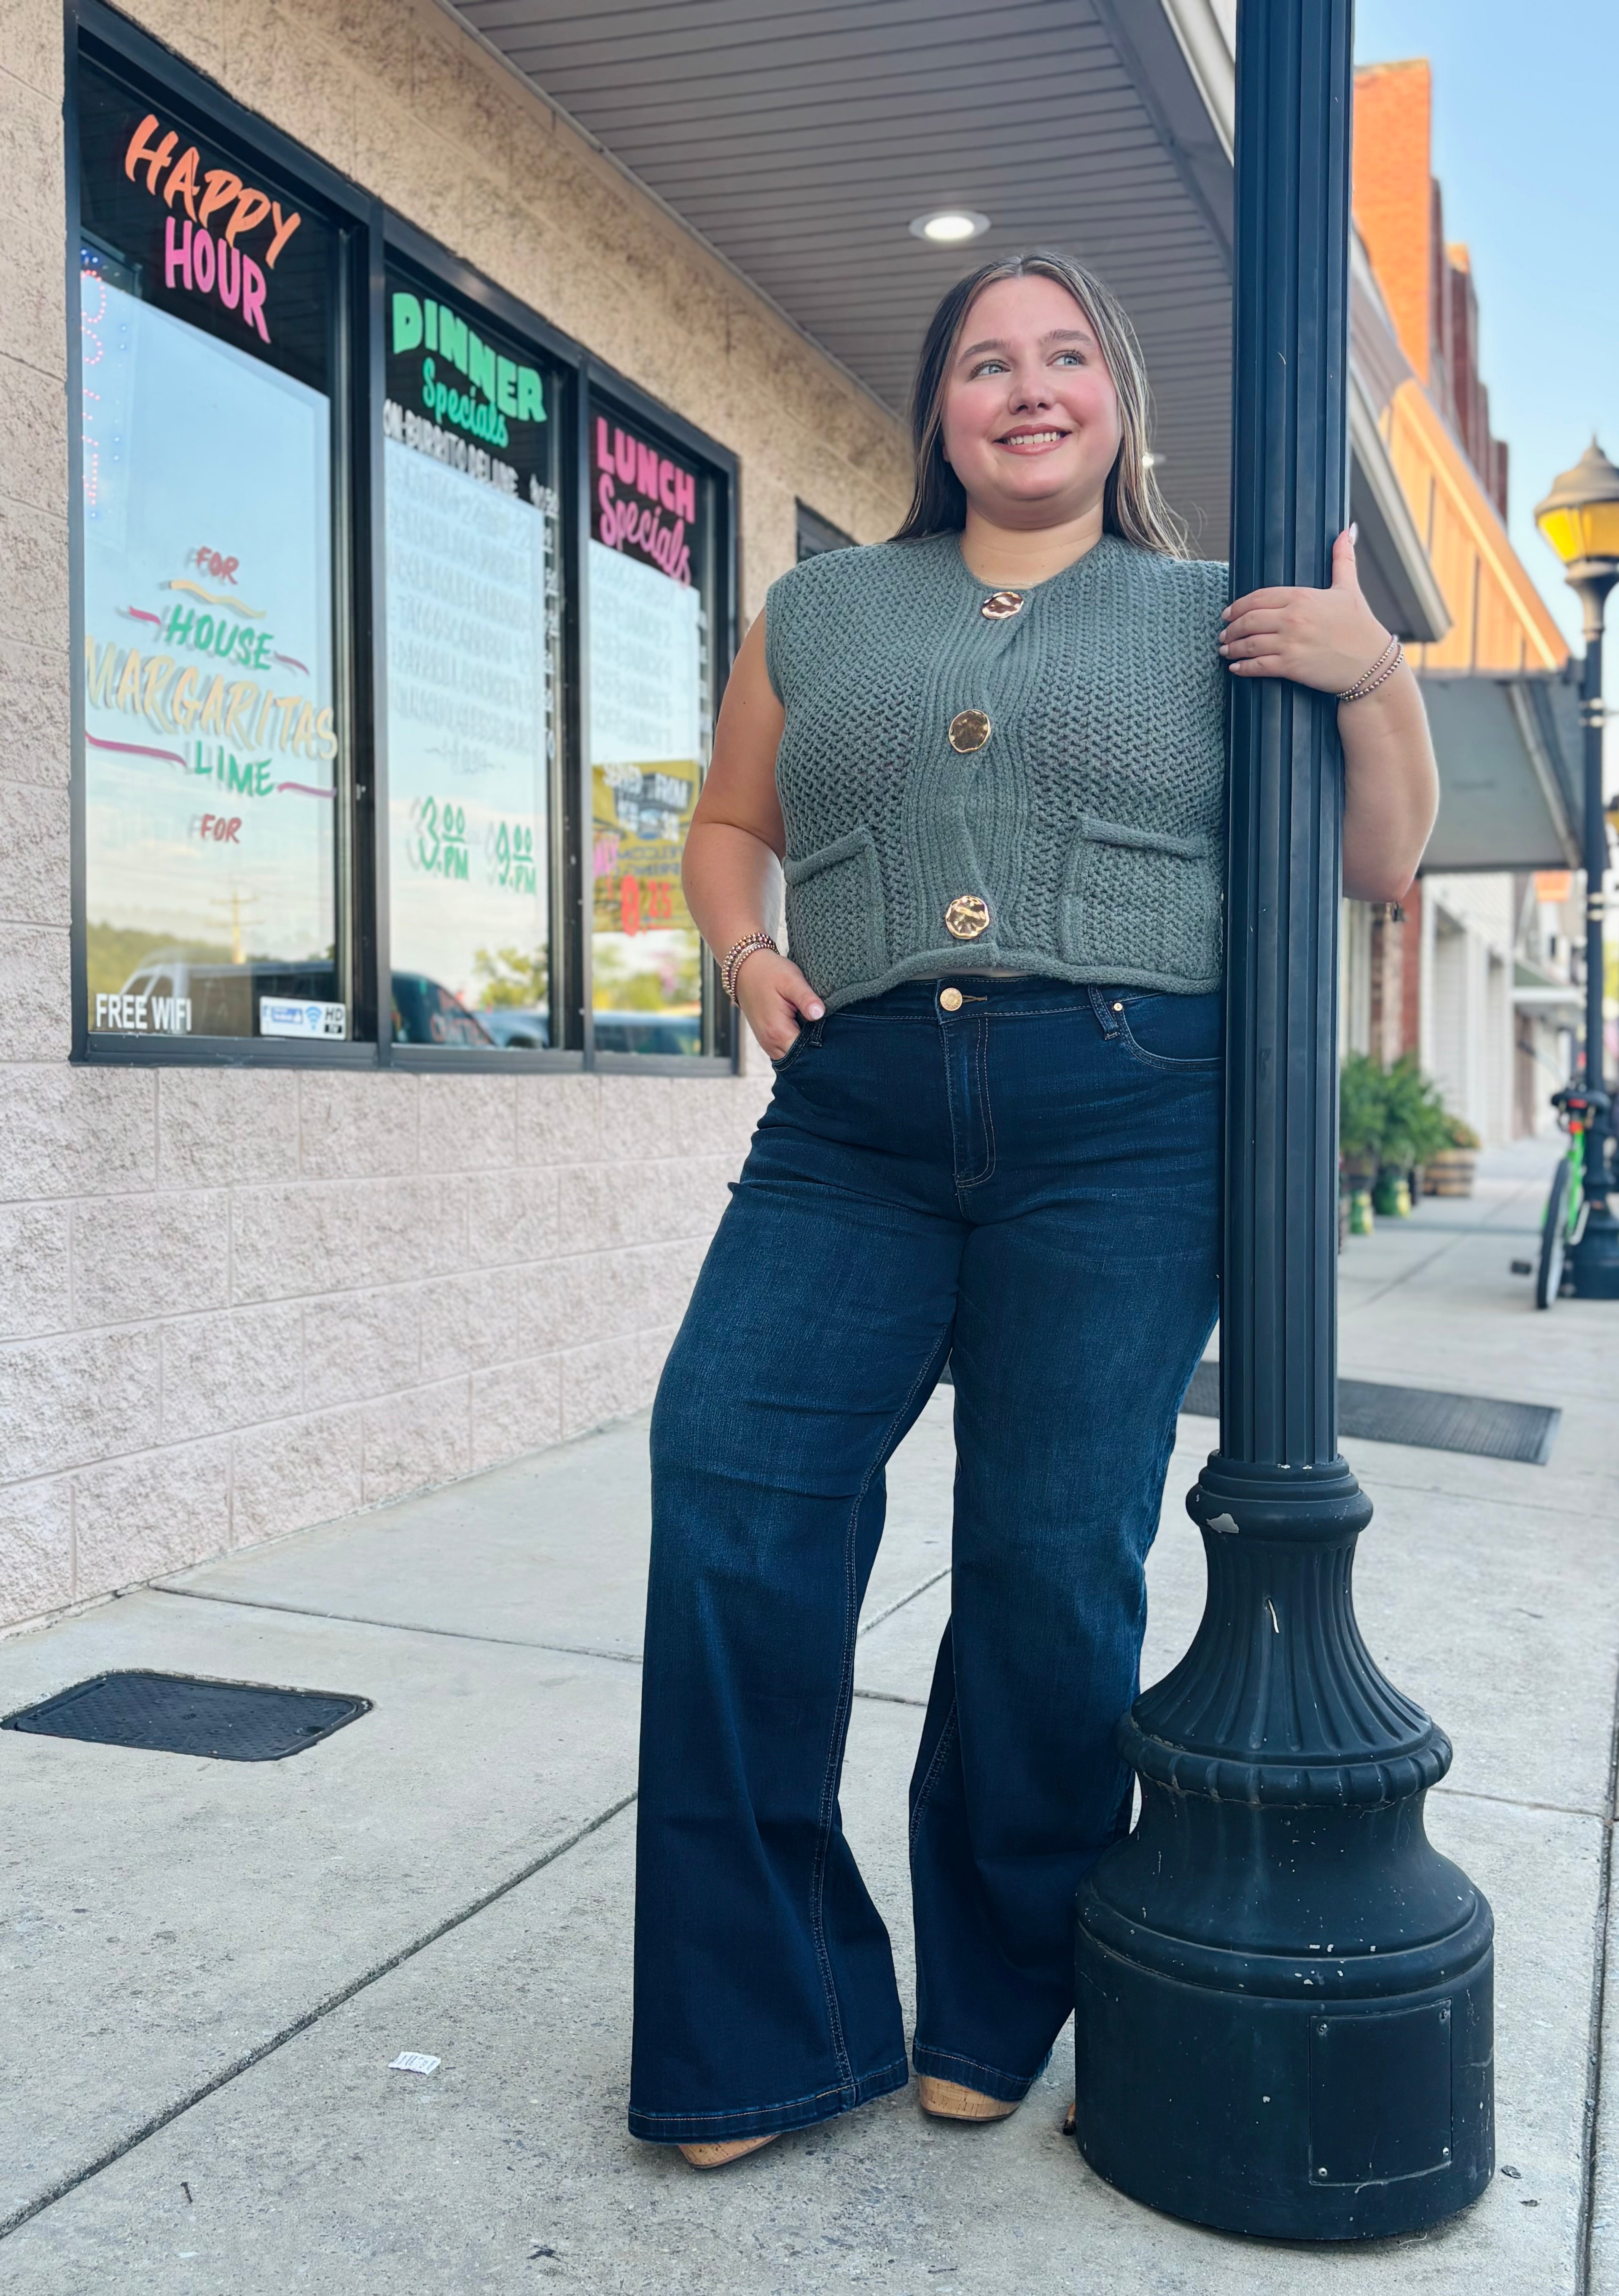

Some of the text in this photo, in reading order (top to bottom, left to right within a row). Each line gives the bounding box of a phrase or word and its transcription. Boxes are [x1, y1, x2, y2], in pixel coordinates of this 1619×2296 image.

[125, 114, 301, 269] HAPPY
[165, 216, 271, 344] HOUR
[393, 293, 547, 422] DINNER
[423, 357, 508, 448] Specials
[597, 416, 695, 524] LUNCH
[197, 547, 239, 584] FOR
[598, 473, 691, 589] Specials
[168, 604, 274, 670] HOUSE
[195, 740, 273, 797] LIME
[200, 814, 242, 843] FOR
[96, 993, 191, 1031] FREE WIFI
